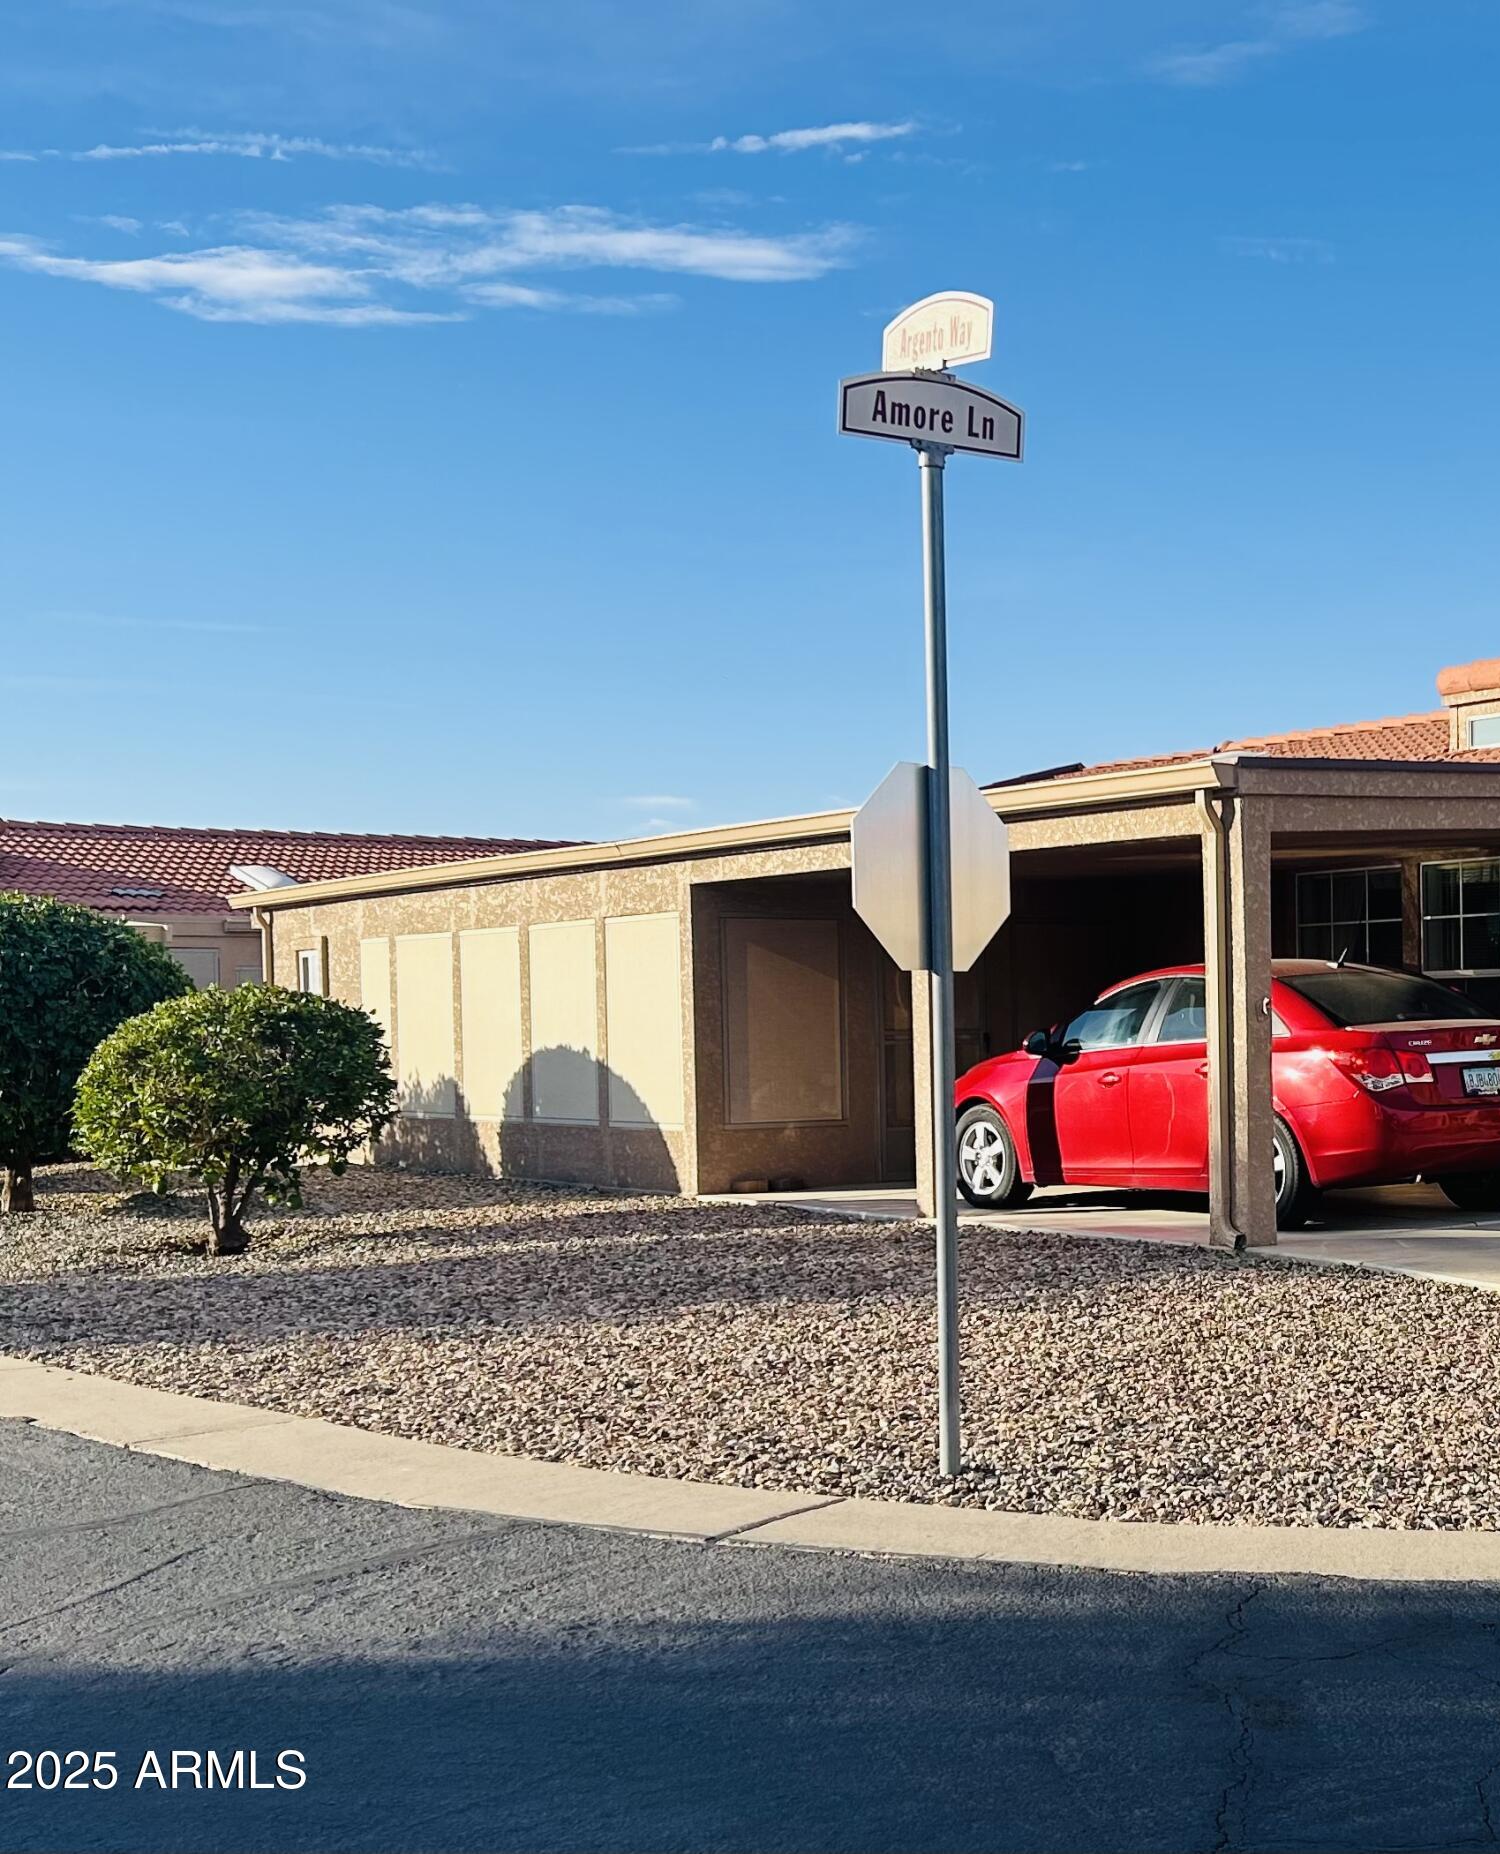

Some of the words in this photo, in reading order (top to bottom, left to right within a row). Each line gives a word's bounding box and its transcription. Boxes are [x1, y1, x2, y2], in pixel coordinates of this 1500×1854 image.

[901, 323, 943, 361] Argento
[950, 316, 973, 351] Way
[872, 390, 954, 434] Amore
[967, 406, 995, 441] Ln
